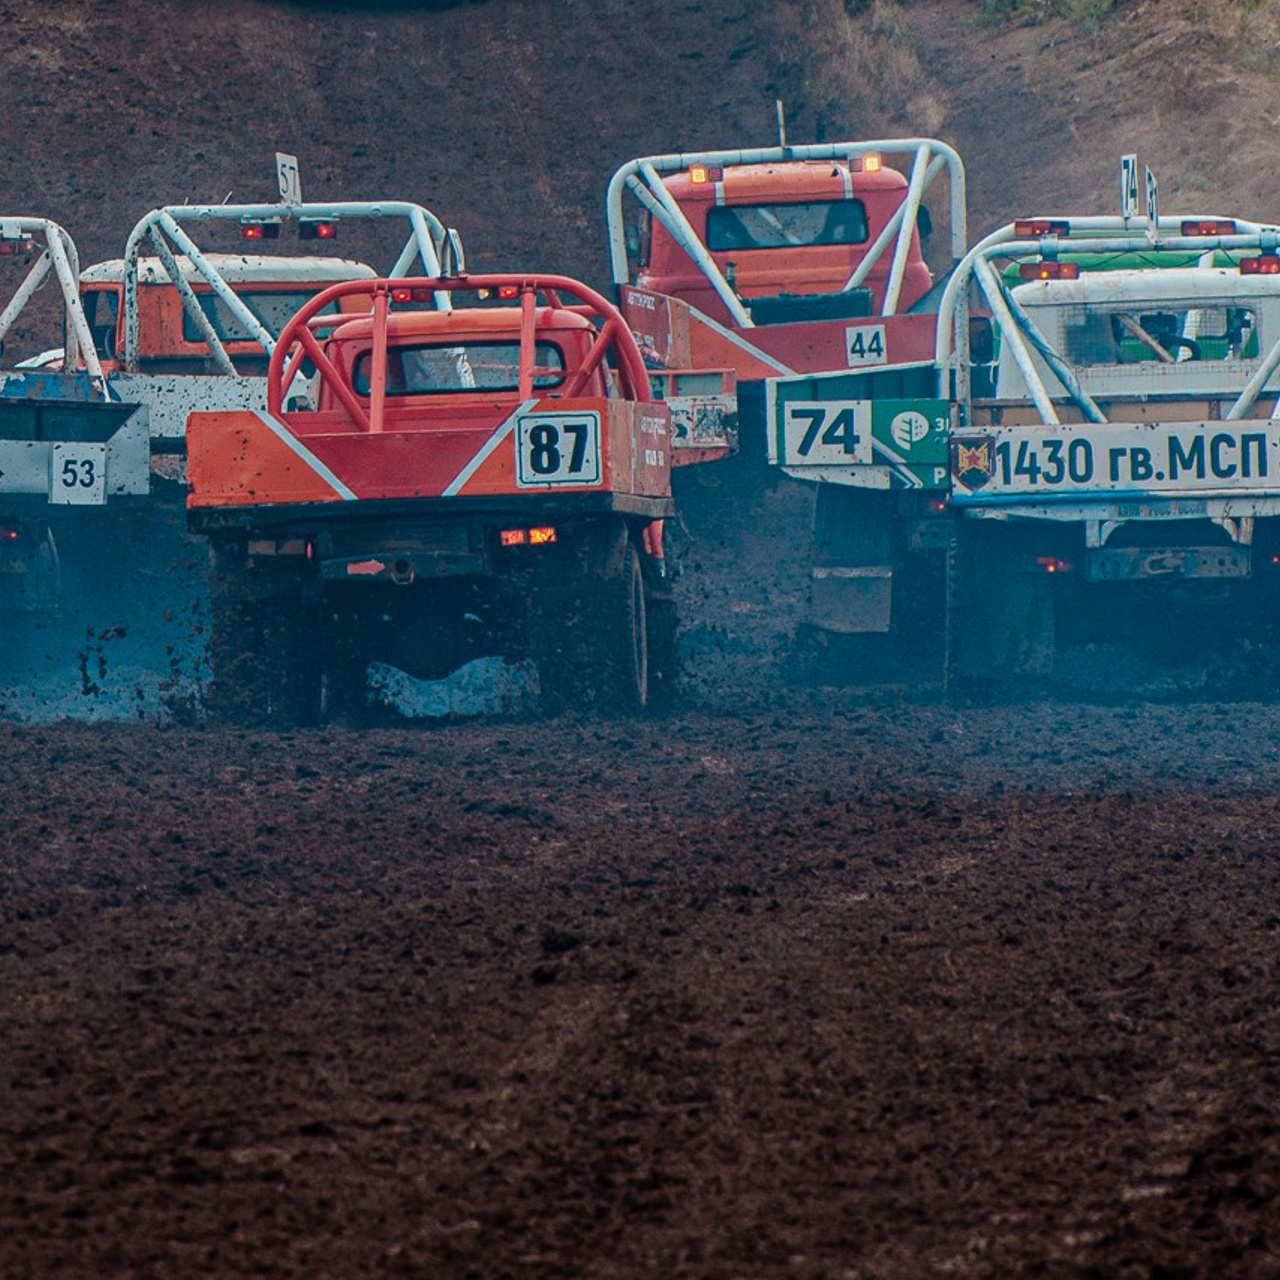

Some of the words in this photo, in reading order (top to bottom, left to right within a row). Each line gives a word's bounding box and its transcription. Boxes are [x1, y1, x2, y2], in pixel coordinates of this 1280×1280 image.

[281, 163, 296, 196] 57
[850, 331, 883, 359] 44
[530, 424, 588, 474] 87
[791, 408, 861, 456] 74
[62, 459, 95, 488] 53
[996, 438, 1093, 485] 1430
